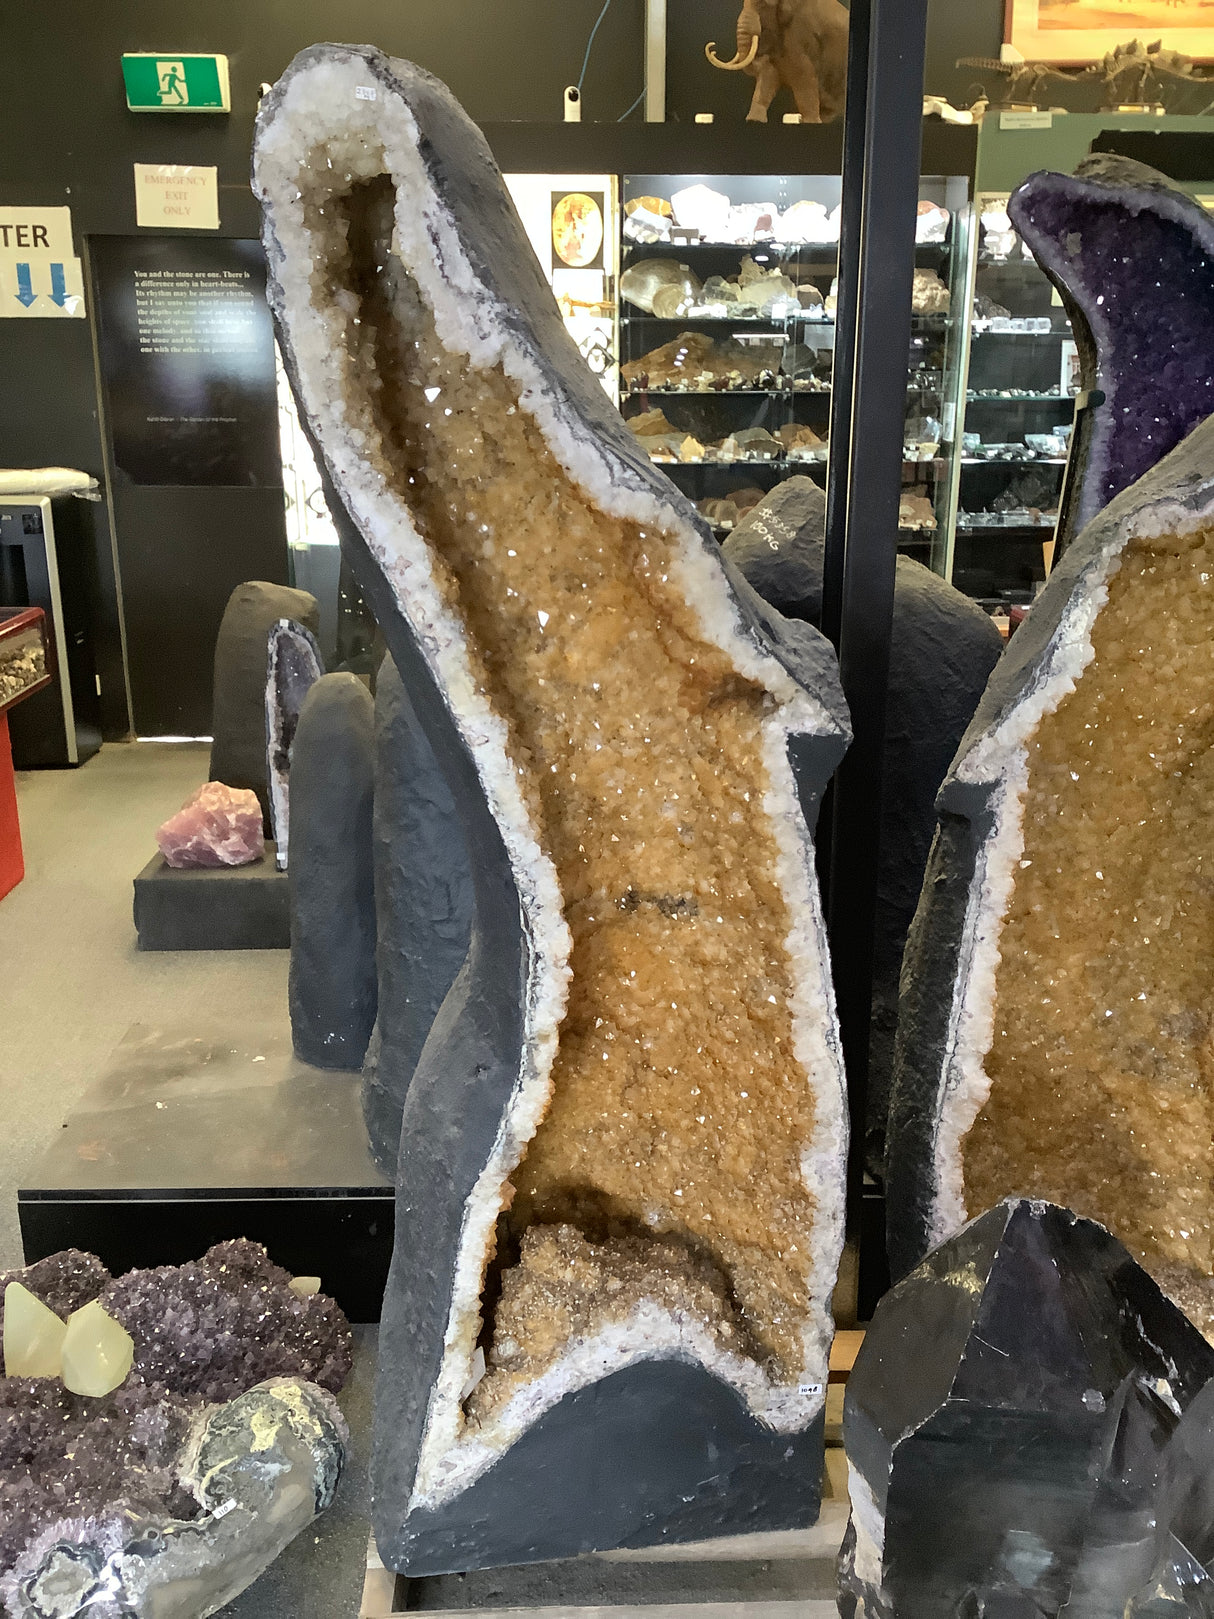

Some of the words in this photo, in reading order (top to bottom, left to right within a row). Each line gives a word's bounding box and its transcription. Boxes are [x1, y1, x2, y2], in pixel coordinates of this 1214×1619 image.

[144, 175, 207, 185] EMERGENCY
[165, 191, 189, 200] EXIT
[163, 206, 191, 215] ONLY
